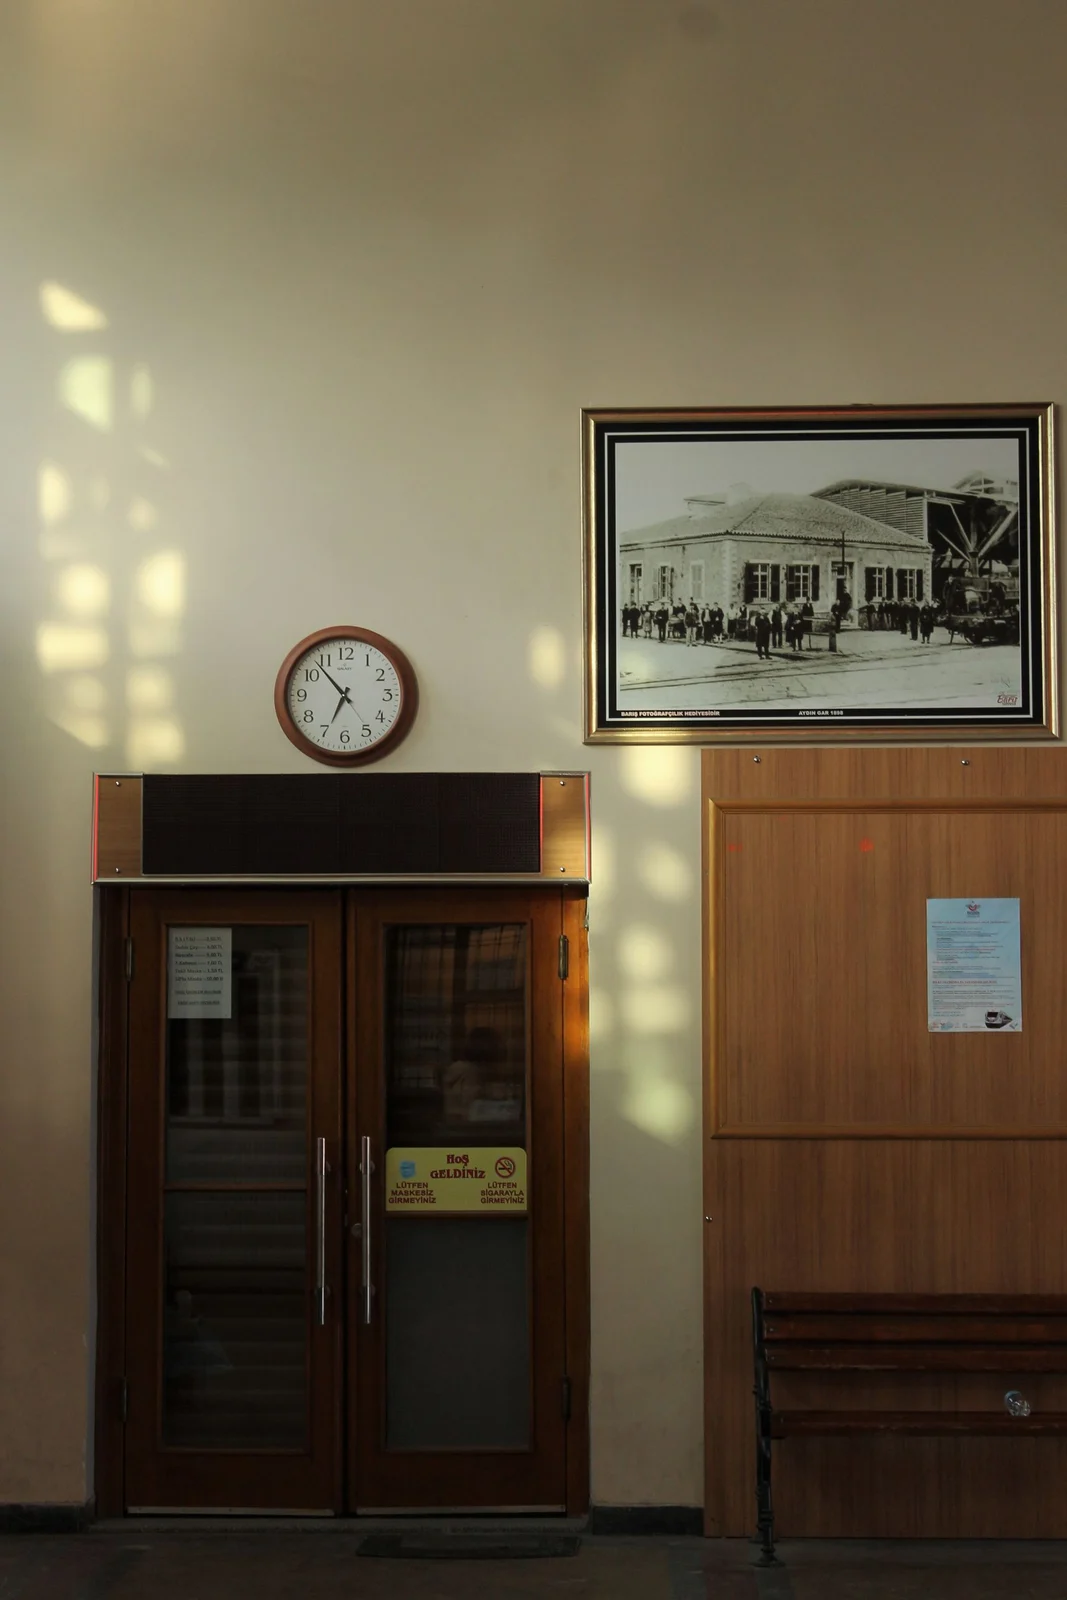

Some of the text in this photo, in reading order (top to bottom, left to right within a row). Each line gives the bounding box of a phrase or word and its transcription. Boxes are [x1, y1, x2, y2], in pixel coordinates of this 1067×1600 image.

[338, 647, 354, 660] 12
[320, 654, 331, 667] 11
[365, 654, 370, 667] 1
[305, 668, 320, 682] 10
[376, 668, 385, 681] 2
[296, 689, 307, 702] 9
[382, 689, 393, 702] 3
[303, 710, 314, 723] 8
[375, 710, 385, 723] 4
[320, 725, 329, 737] 7
[340, 730, 350, 743] 6
[361, 724, 372, 737] 5
